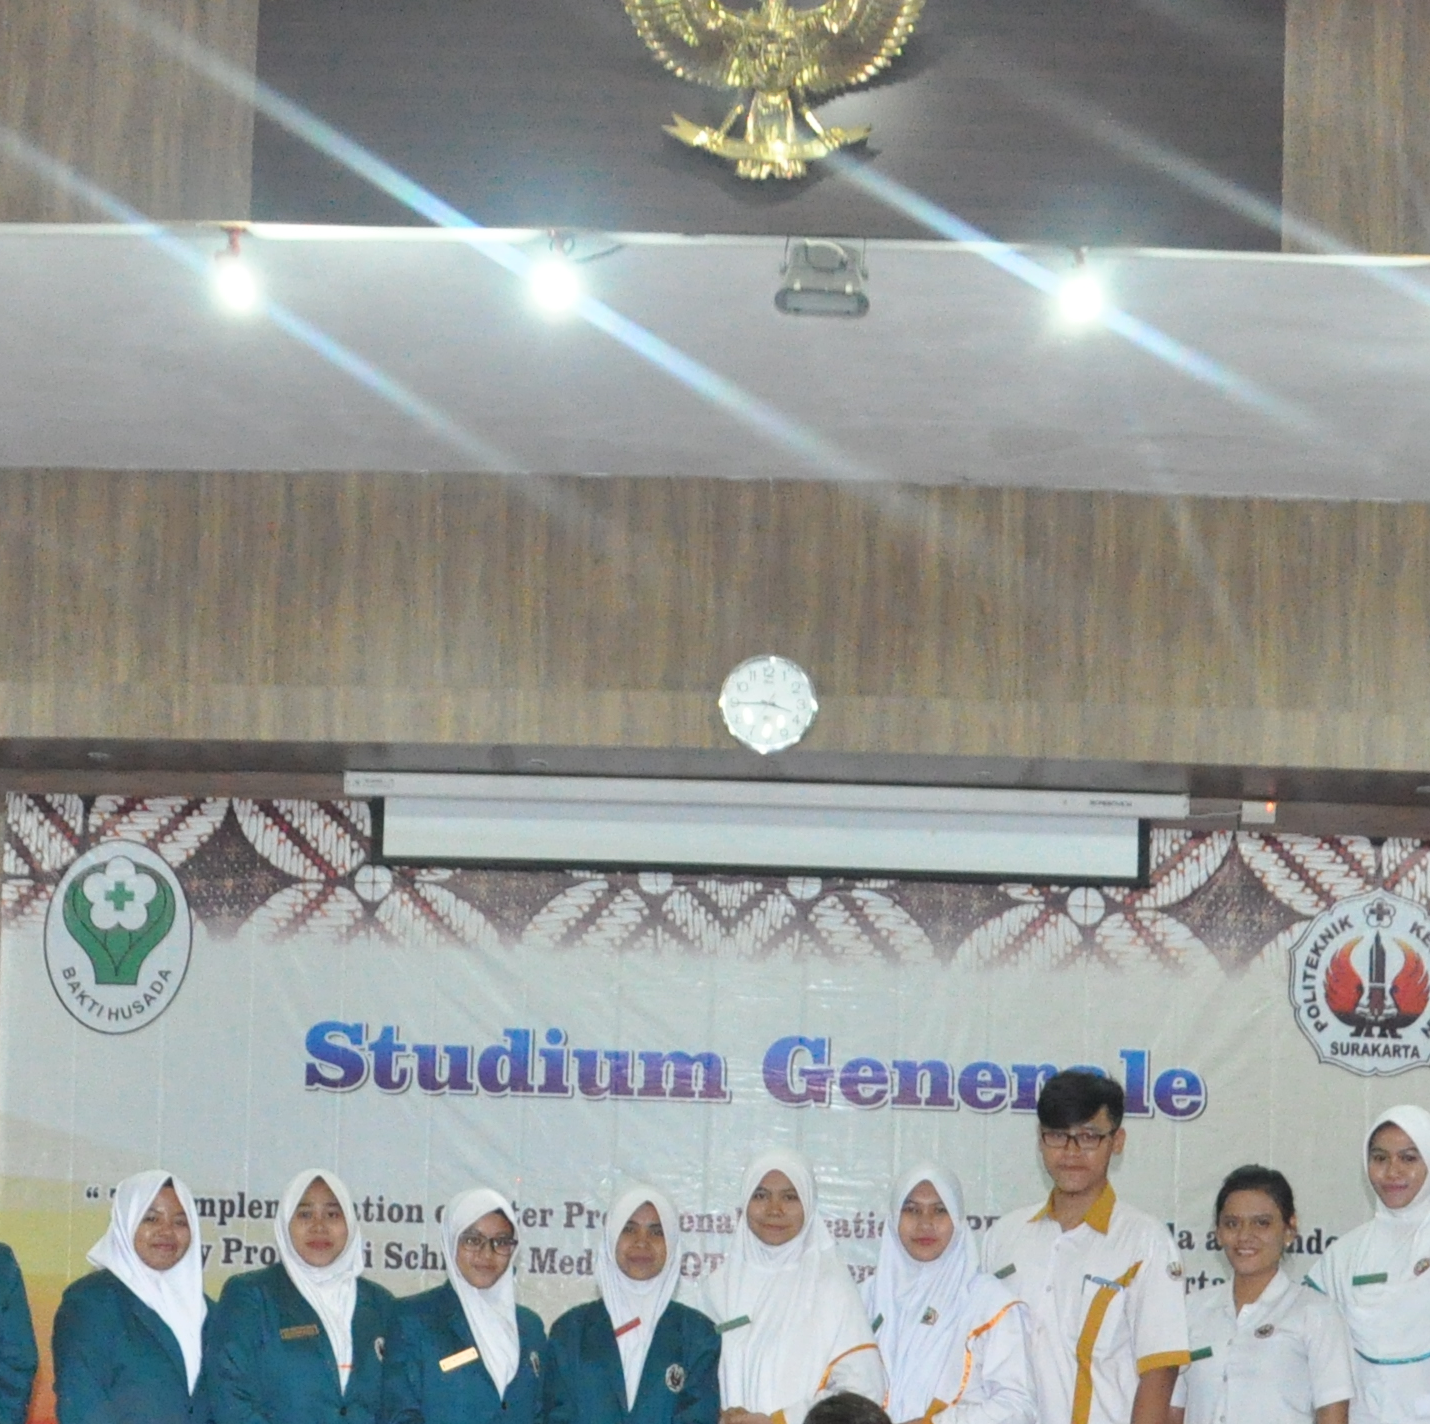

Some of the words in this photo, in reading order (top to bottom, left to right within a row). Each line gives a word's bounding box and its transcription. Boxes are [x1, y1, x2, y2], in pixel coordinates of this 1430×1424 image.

[62, 966, 105, 1018] BAKTI
[107, 968, 172, 1021] HUSADA
[1302, 915, 1354, 1033] POLITEKNIK
[305, 1020, 730, 1101] Studium
[1330, 1041, 1421, 1059] SURAKARTA
